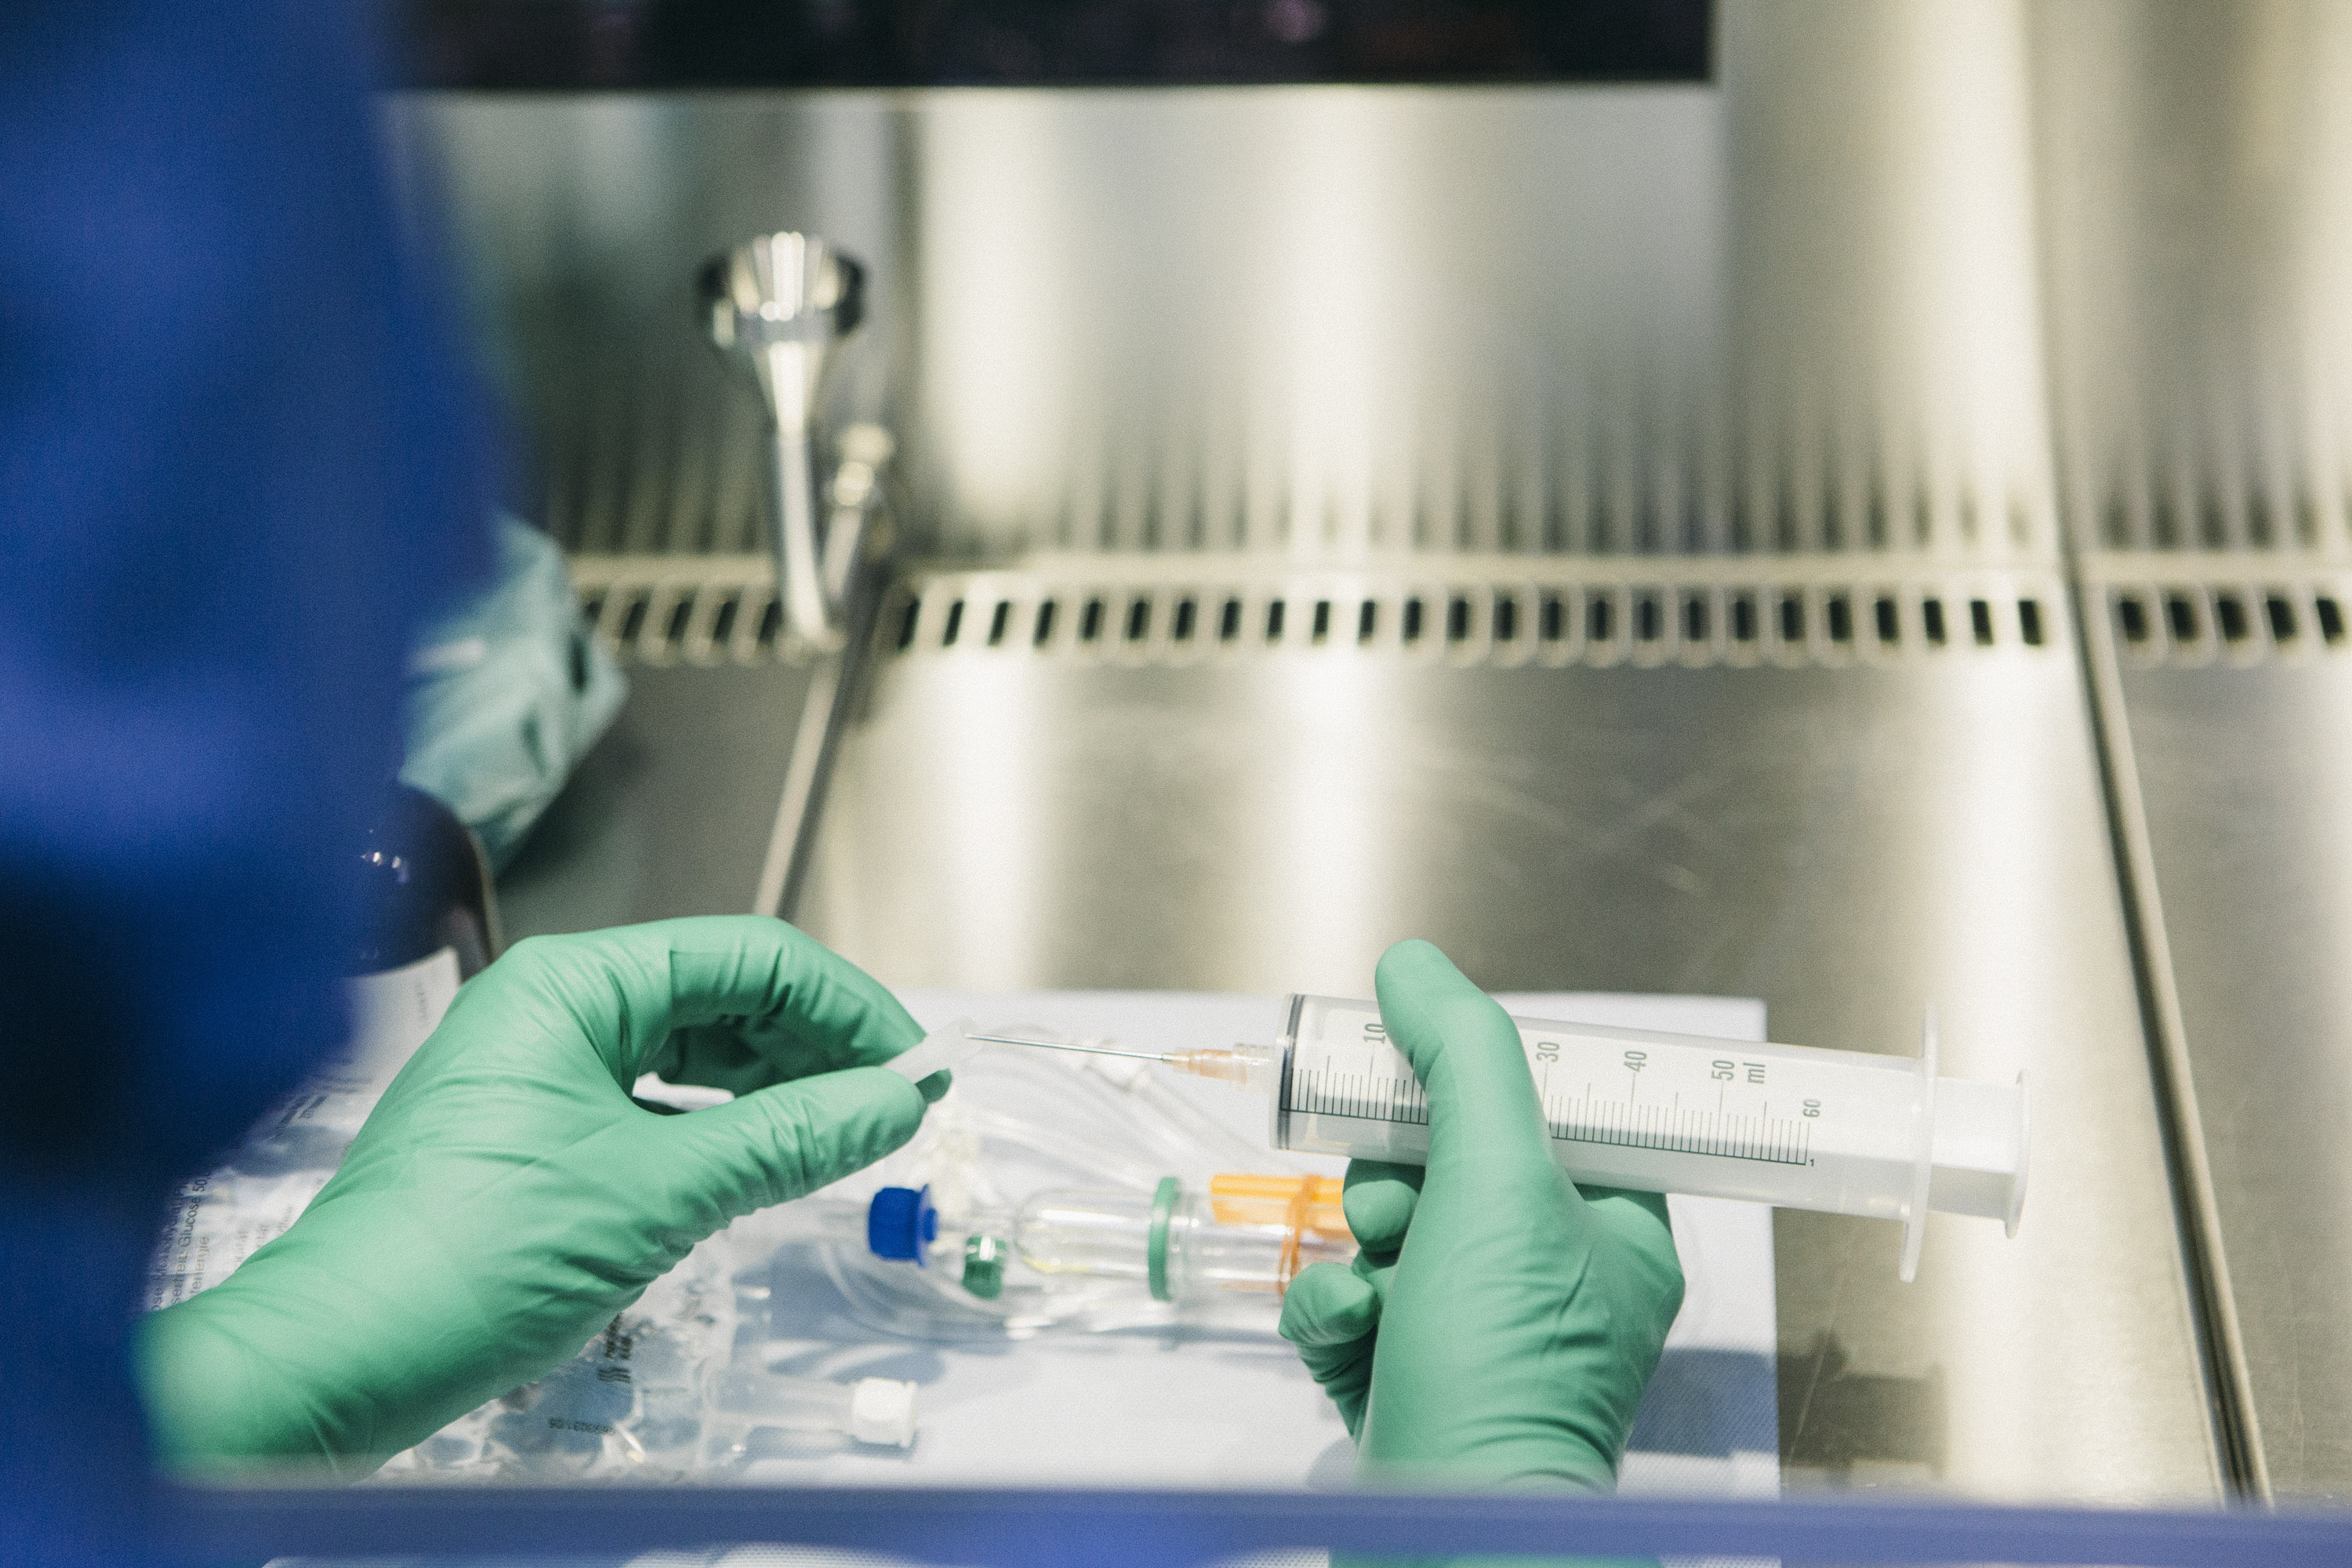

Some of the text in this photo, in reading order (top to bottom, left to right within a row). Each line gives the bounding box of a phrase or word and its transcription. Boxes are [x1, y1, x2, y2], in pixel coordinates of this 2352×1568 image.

[1363, 1023, 1386, 1044] 10
[1536, 1042, 1560, 1063] 30
[1624, 1051, 1647, 1073] 40
[1711, 1060, 1735, 1081] 50
[1743, 1062, 1766, 1083] ml
[1802, 1099, 1820, 1117] 60
[178, 1196, 201, 1248] Glucose
